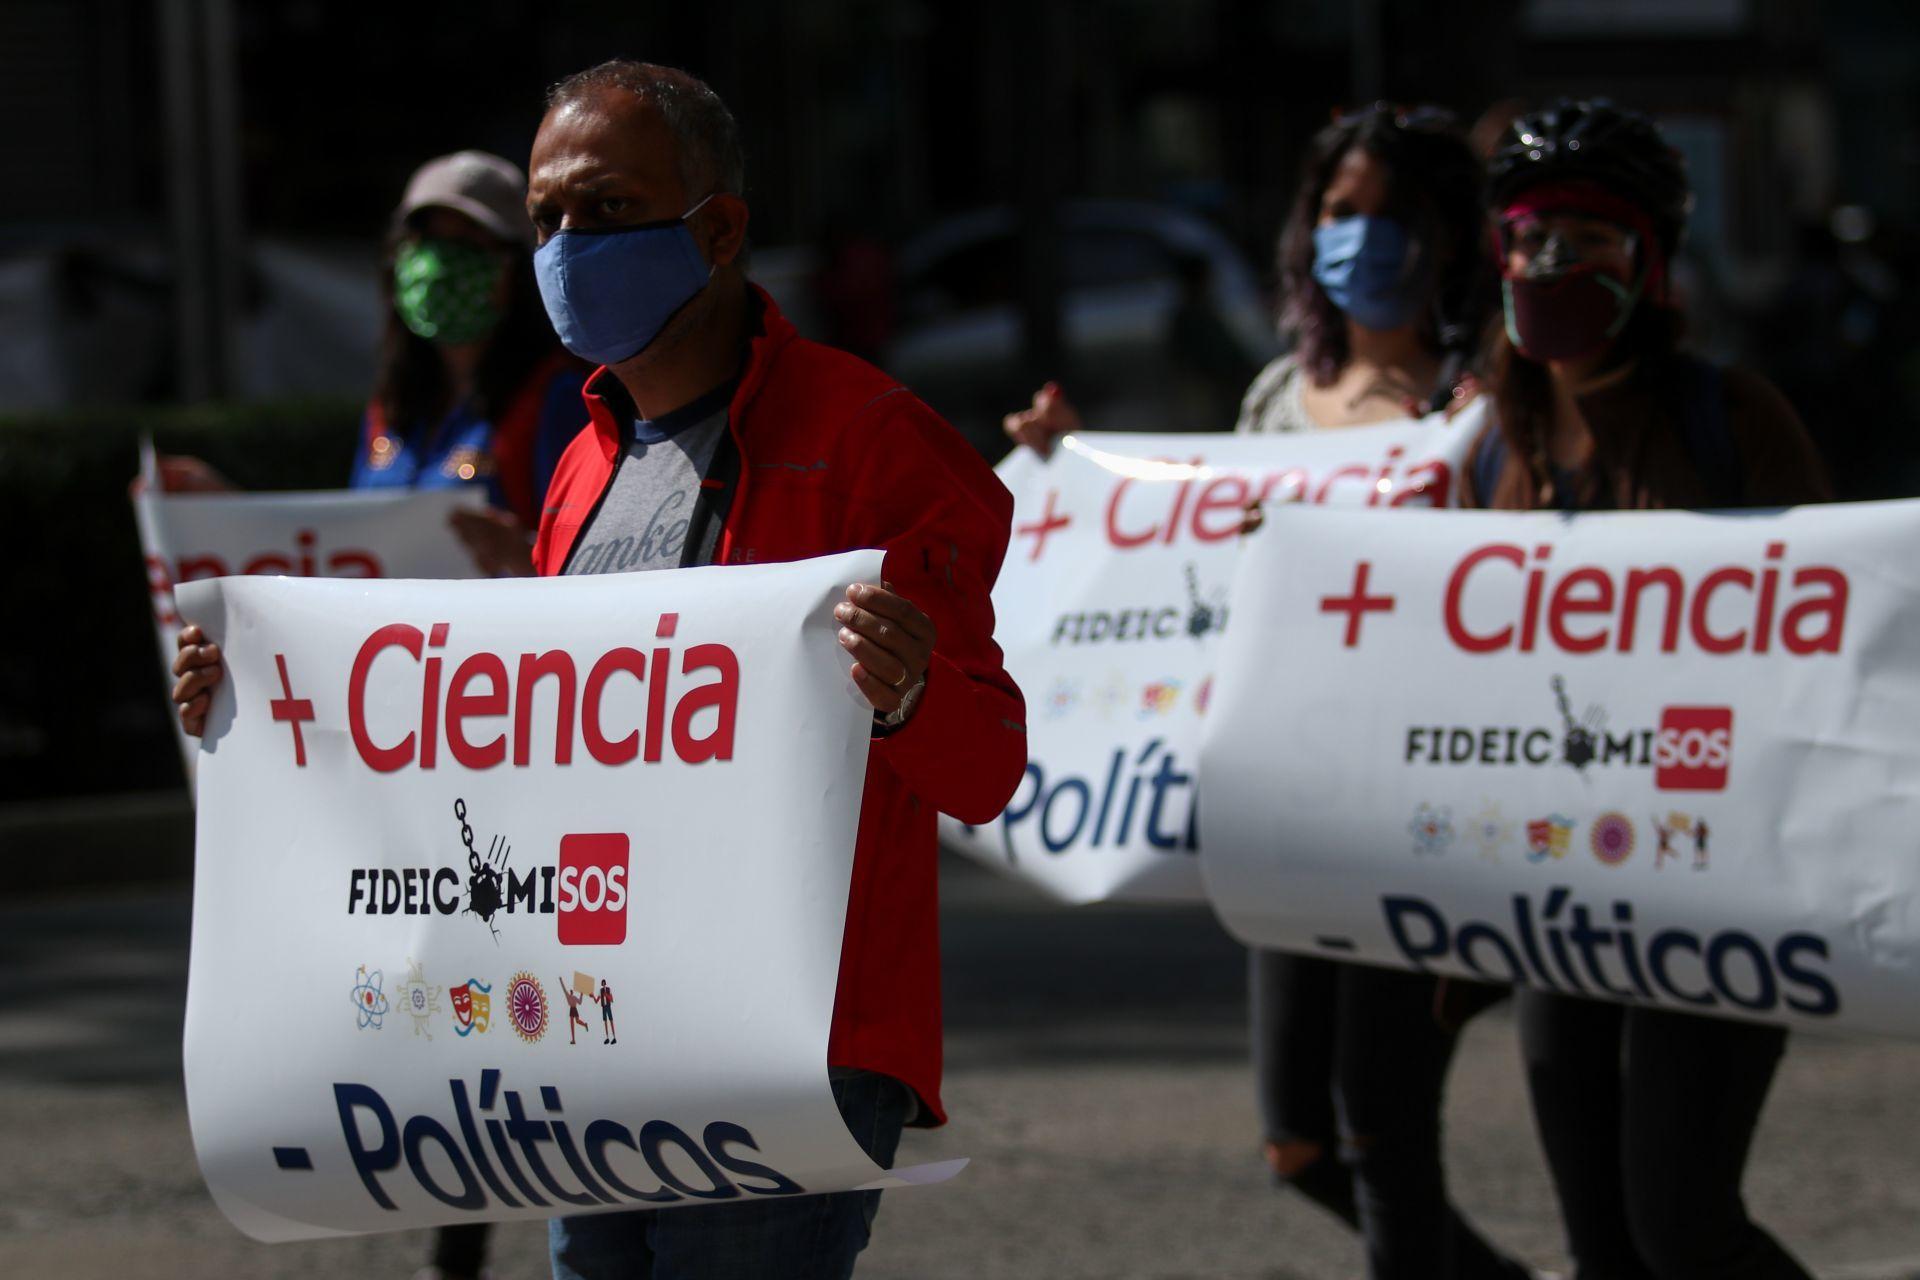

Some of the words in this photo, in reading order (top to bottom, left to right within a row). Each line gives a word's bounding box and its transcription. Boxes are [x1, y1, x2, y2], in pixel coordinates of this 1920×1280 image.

[1051, 606, 1230, 646] FIDEIC
[1442, 542, 1849, 655] Ciencia
[348, 613, 741, 773] Ciencia
[1405, 726, 1731, 769] FIDEICMISOS
[348, 863, 627, 917] FIDEICMISOS
[1380, 886, 1841, 1016] Políticos
[333, 1068, 804, 1210] Políticos
